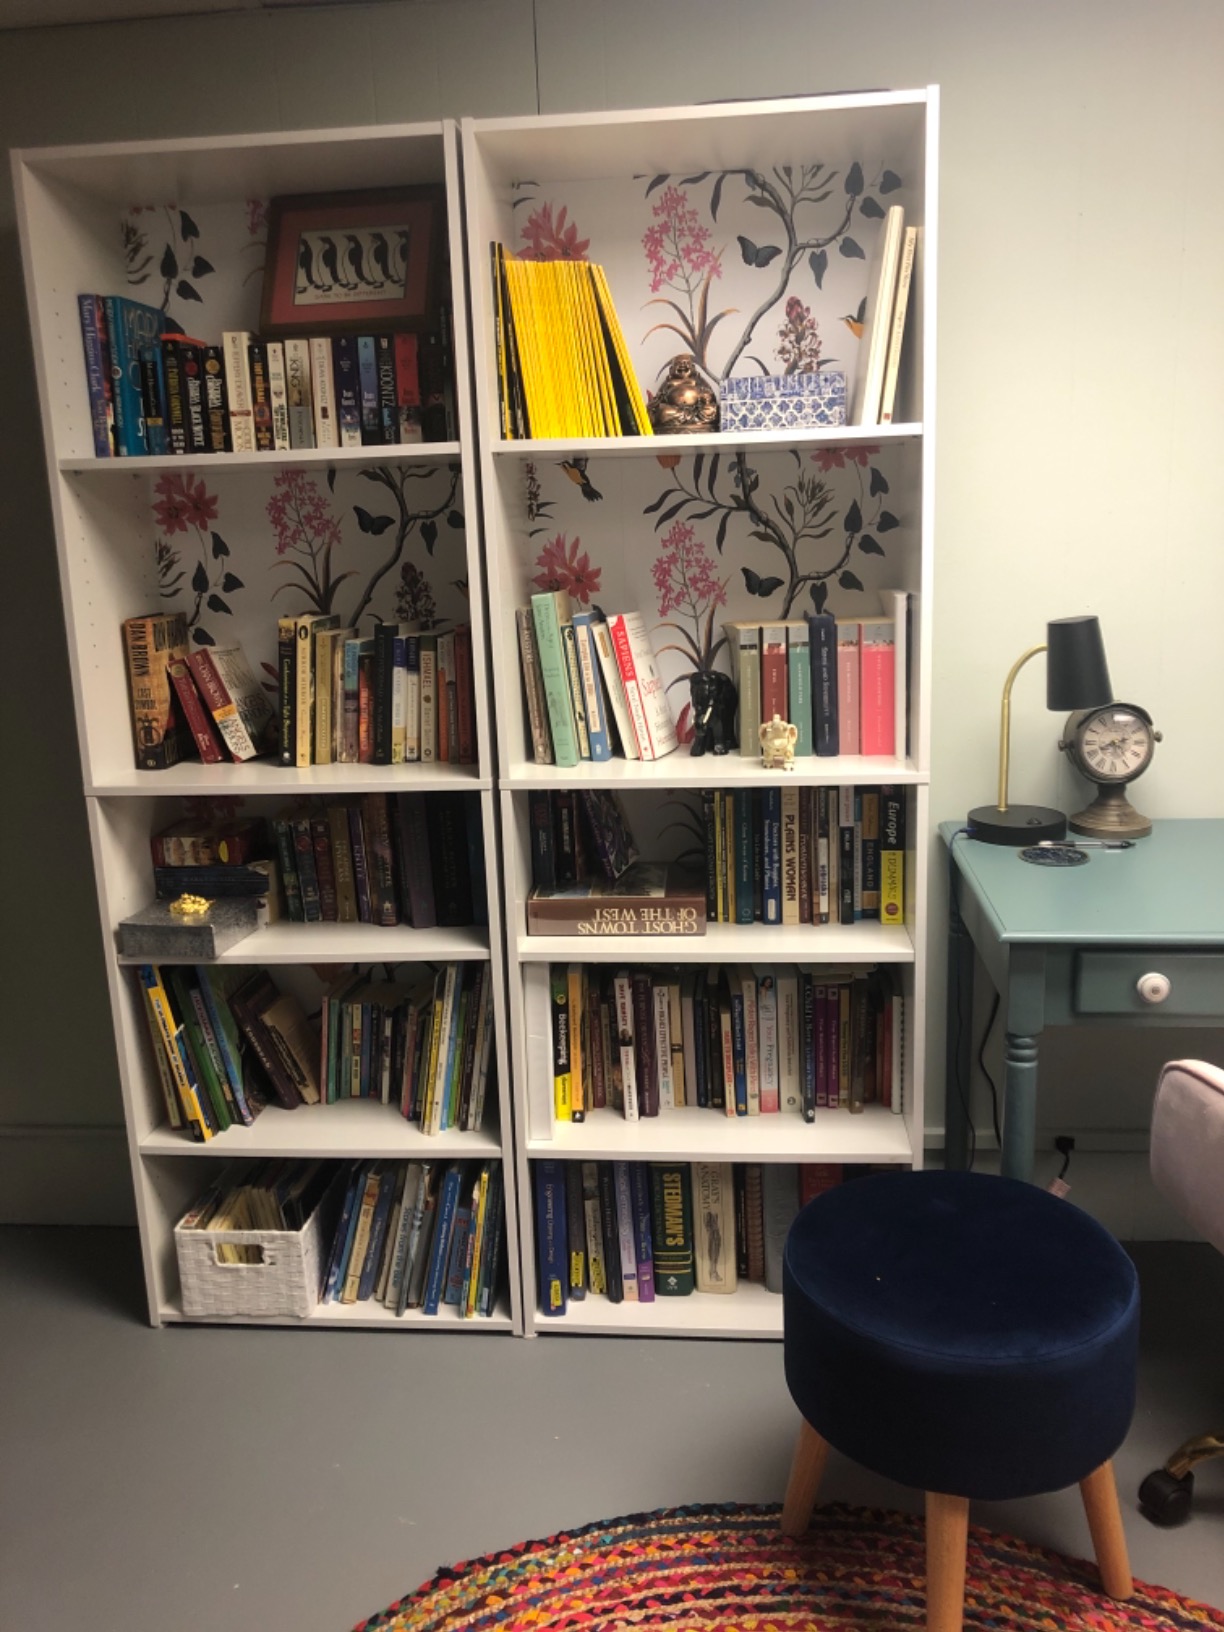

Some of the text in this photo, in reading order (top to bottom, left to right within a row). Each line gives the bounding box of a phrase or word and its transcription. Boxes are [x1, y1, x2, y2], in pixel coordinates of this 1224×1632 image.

[379, 364, 394, 407] KOONTZ
[129, 622, 150, 677] DAN BROWN
[422, 653, 430, 688] ISHMAEL
[614, 629, 634, 678] SAPIENS
[885, 801, 900, 844] Europe
[784, 814, 795, 901] PLAINS WOMAN
[866, 841, 874, 888] ENGLAND
[577, 922, 698, 935] GHOST TOWNS
[594, 907, 697, 922] OF THE WEST
[557, 1013, 567, 1065] Beekeeping
[765, 1044, 774, 1085] Pregnancy
[663, 1172, 683, 1245] STEDMAN'S
[700, 1164, 710, 1210] ANATOMY
[710, 1170, 719, 1203] GRAY'S
